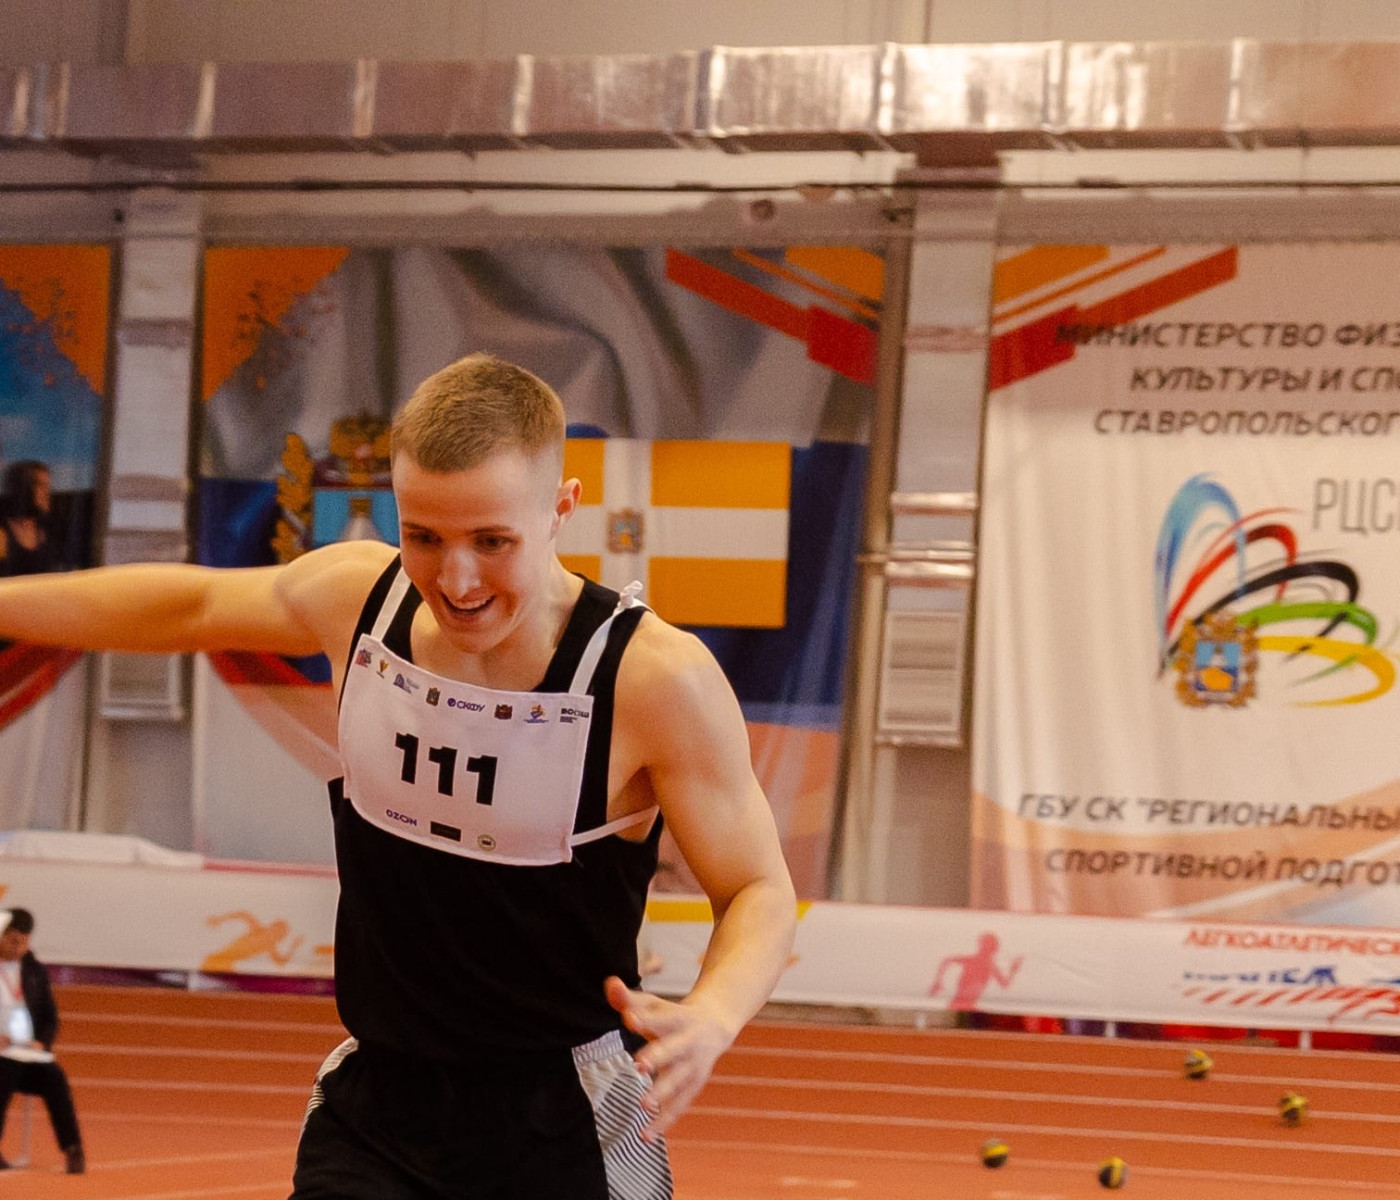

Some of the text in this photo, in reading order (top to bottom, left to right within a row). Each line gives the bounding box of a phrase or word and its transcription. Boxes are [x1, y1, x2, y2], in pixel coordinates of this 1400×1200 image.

[1055, 322, 1326, 348] МИНИСТЕРСТВО
[1131, 366, 1312, 392] КУЛЬТУРЫ
[1318, 366, 1343, 392] И
[1094, 409, 1400, 436] СТАВРОПОЛЬСКОГ
[1312, 477, 1400, 536] РЦС
[395, 732, 498, 806] 111
[1018, 794, 1080, 819] ГБУ
[1085, 796, 1128, 821] СК
[1046, 847, 1267, 881] СПОРТИВНОЙ
